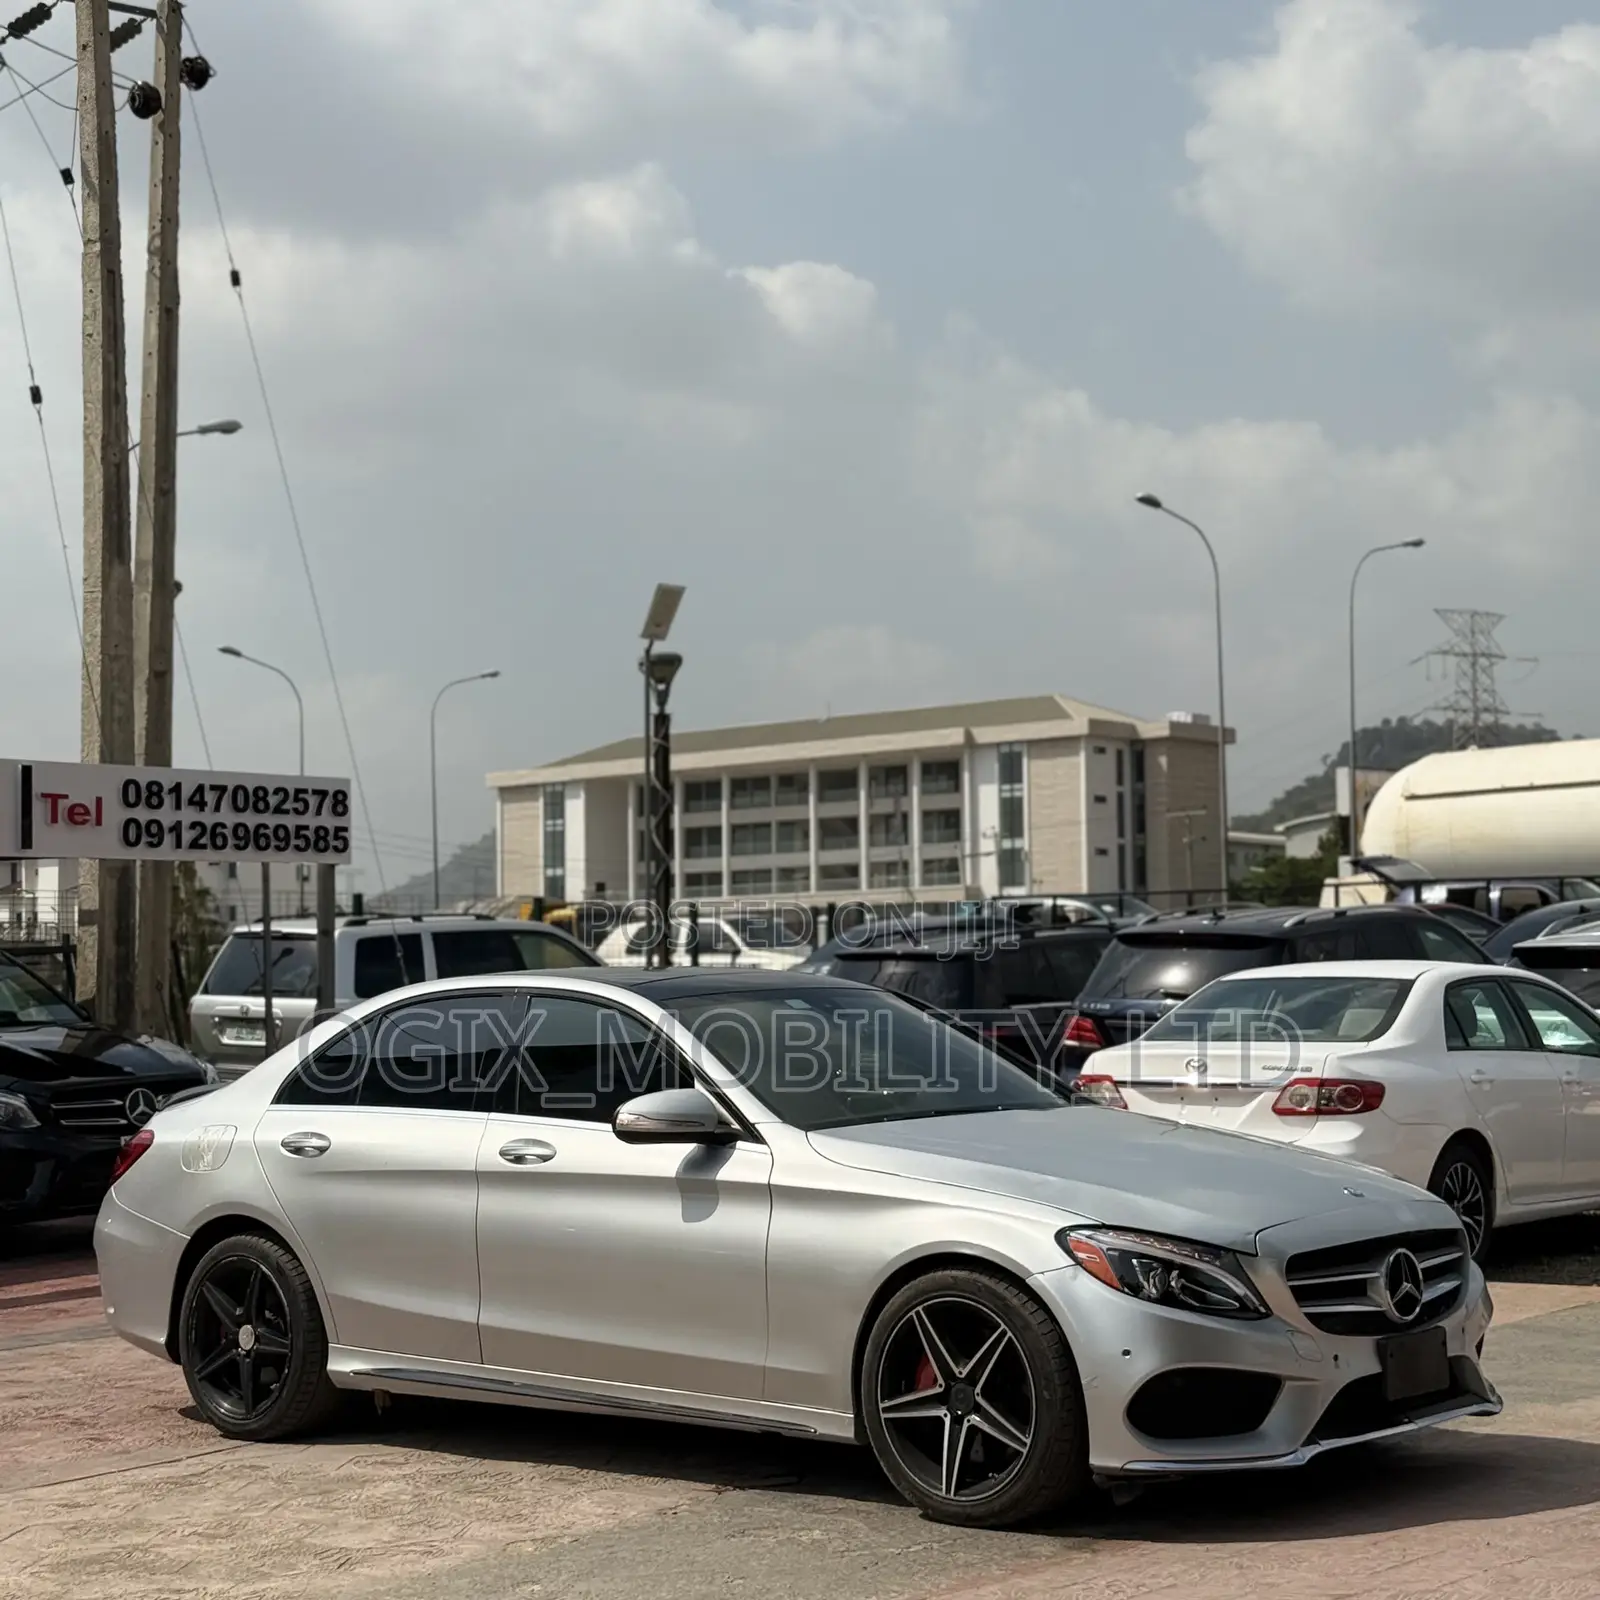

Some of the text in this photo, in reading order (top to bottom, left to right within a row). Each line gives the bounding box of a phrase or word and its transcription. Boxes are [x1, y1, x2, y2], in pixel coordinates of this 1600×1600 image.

[40, 792, 103, 827] Tel
[121, 778, 349, 817] 08147082578
[122, 817, 349, 853] 09126969585
